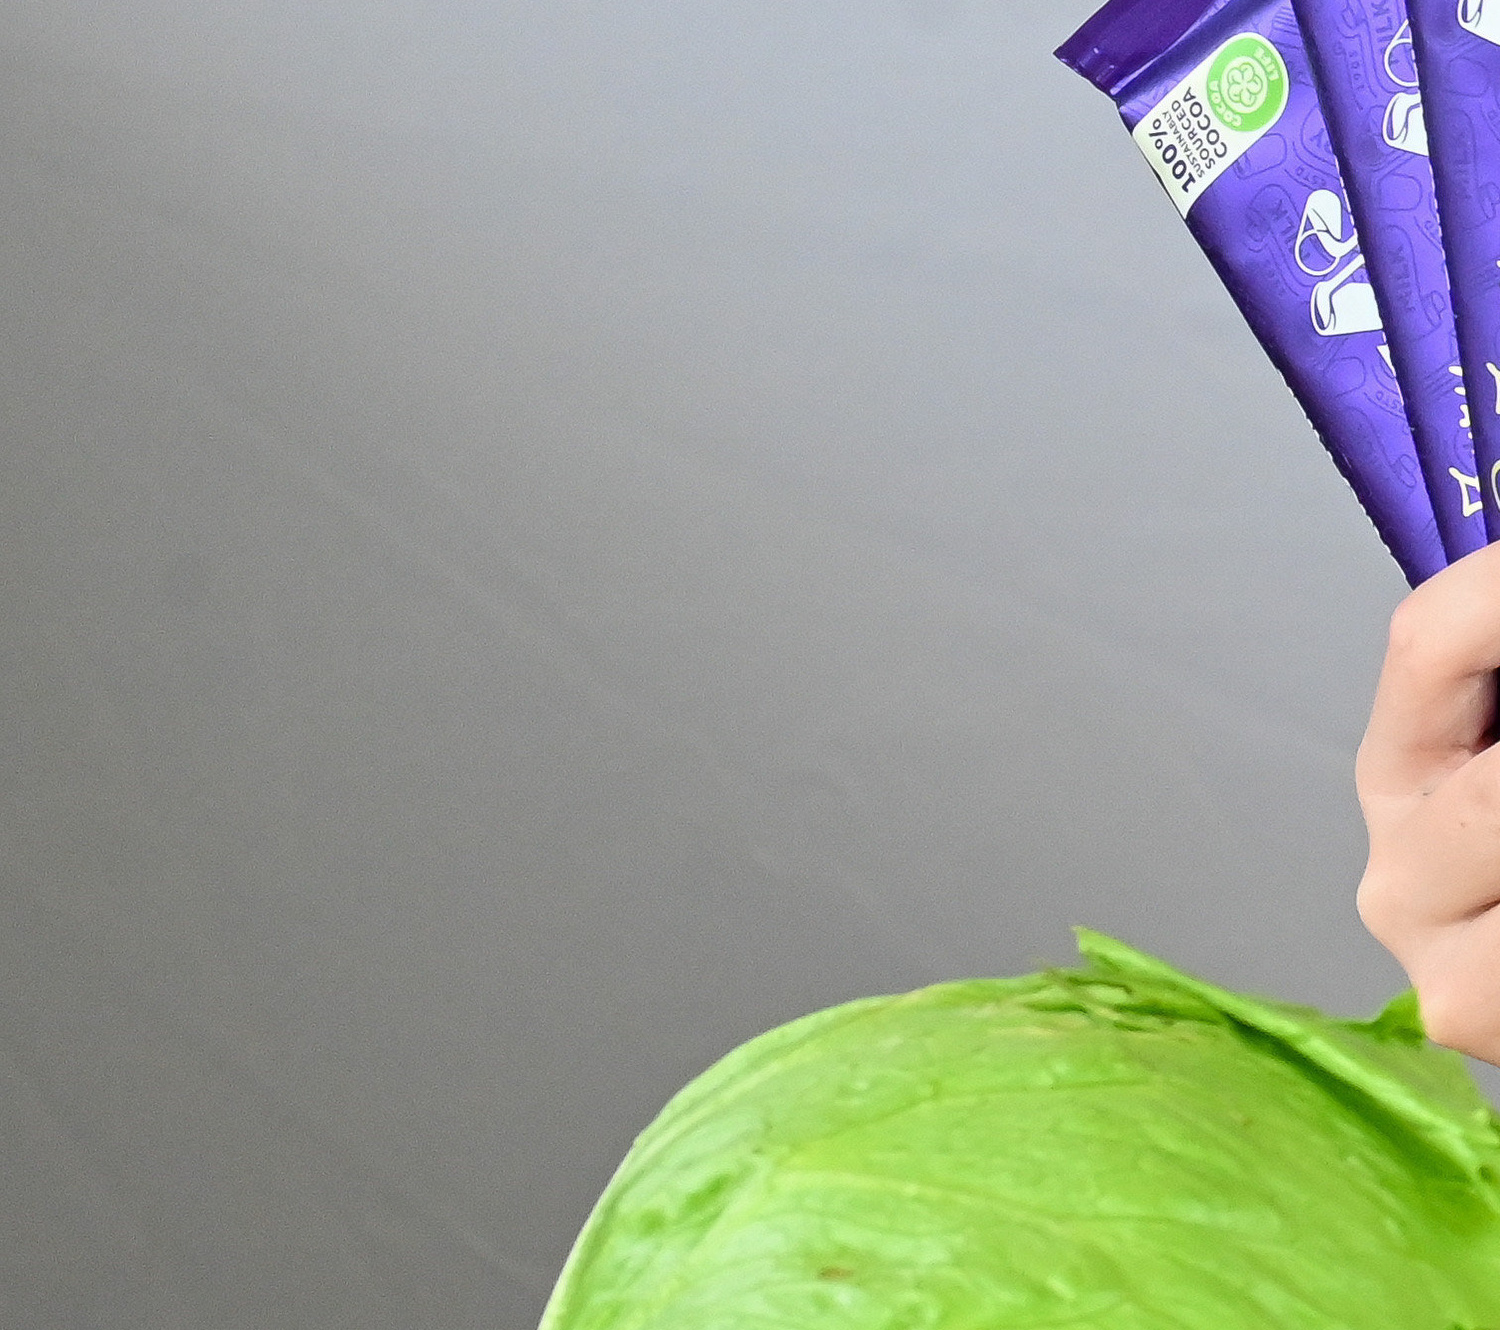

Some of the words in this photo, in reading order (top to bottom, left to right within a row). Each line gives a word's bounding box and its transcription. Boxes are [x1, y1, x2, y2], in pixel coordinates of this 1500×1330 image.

[1171, 100, 1216, 170] SOURCED
[1183, 86, 1228, 158] COCOA
[1208, 80, 1242, 127] COCOA
[1148, 118, 1197, 193] 100%
[1162, 111, 1205, 178] SUSTAINABLY
